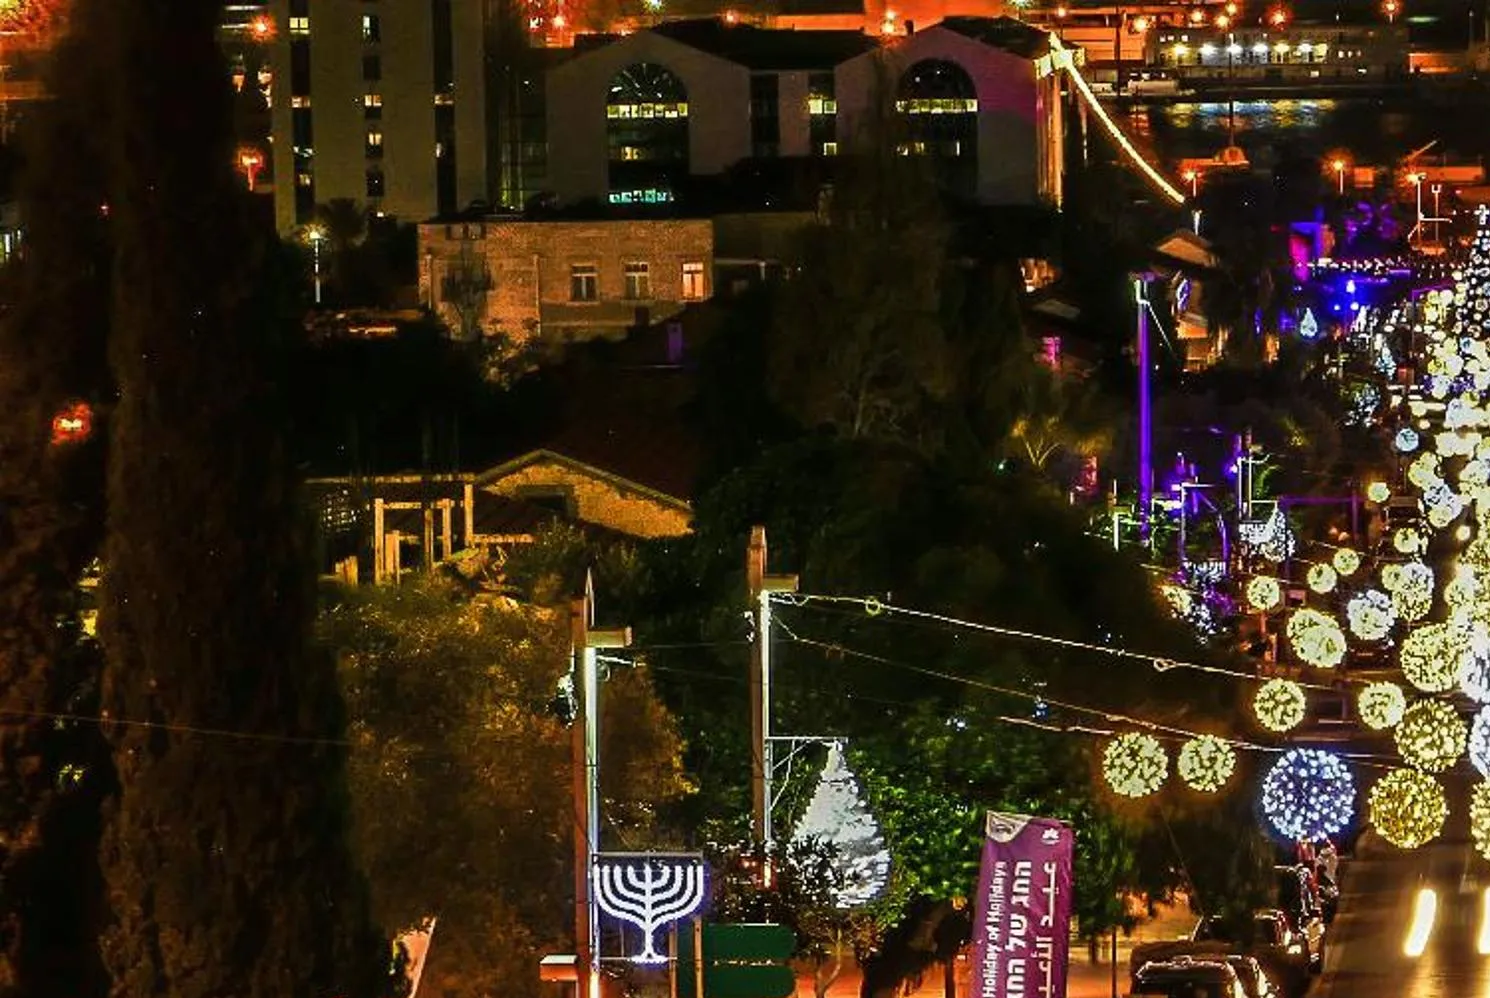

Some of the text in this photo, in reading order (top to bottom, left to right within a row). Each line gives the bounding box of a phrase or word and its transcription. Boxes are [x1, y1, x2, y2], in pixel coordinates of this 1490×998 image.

[985, 860, 1008, 922] Holidays
[1010, 861, 1032, 908] החג
[984, 925, 1001, 940] of
[1004, 913, 1028, 953] של
[981, 943, 1002, 998] Holiday
